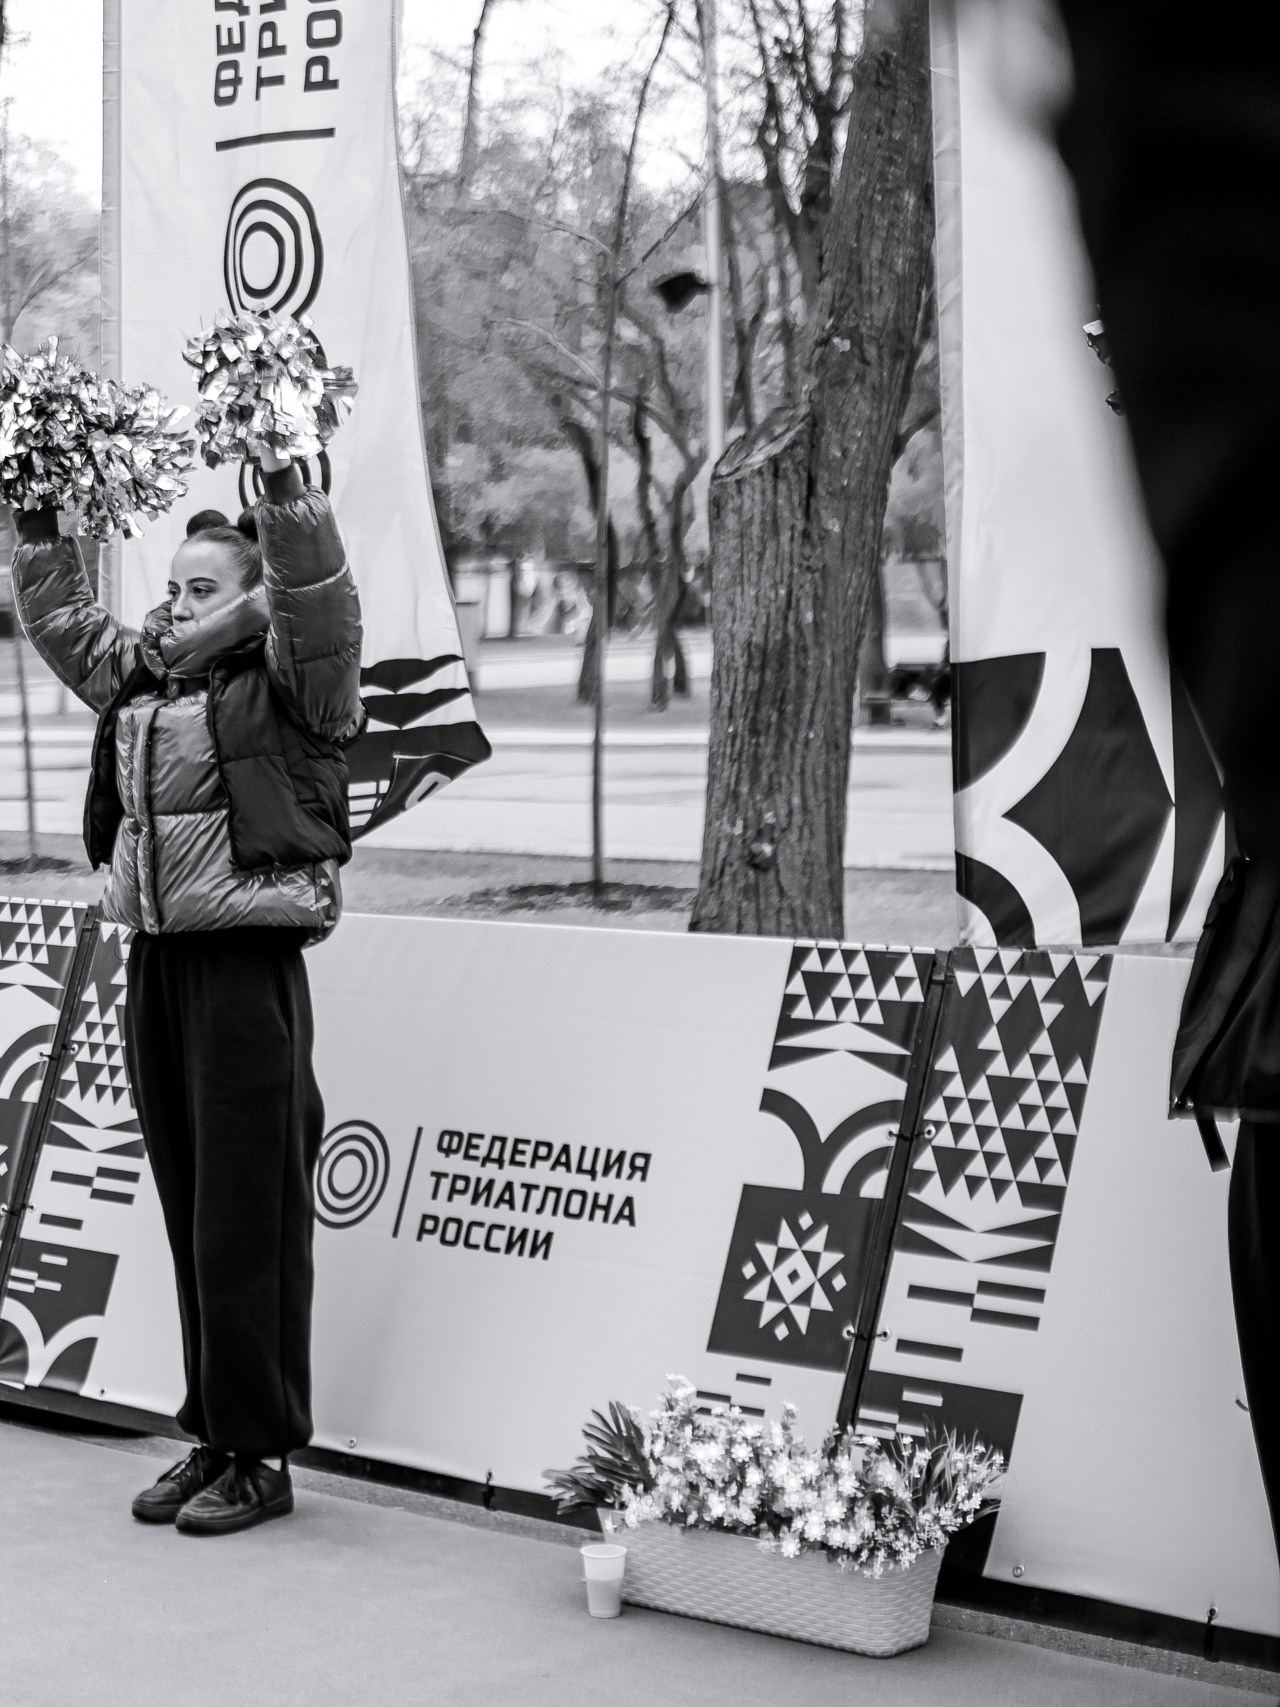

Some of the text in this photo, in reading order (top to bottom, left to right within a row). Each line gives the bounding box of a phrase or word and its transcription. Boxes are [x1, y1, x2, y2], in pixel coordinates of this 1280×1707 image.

[436, 1129, 652, 1183] ФЕДЕРАЦИЯ
[429, 1171, 637, 1227] ТРИАТЛОНА
[416, 1213, 555, 1261] РОССИИ
